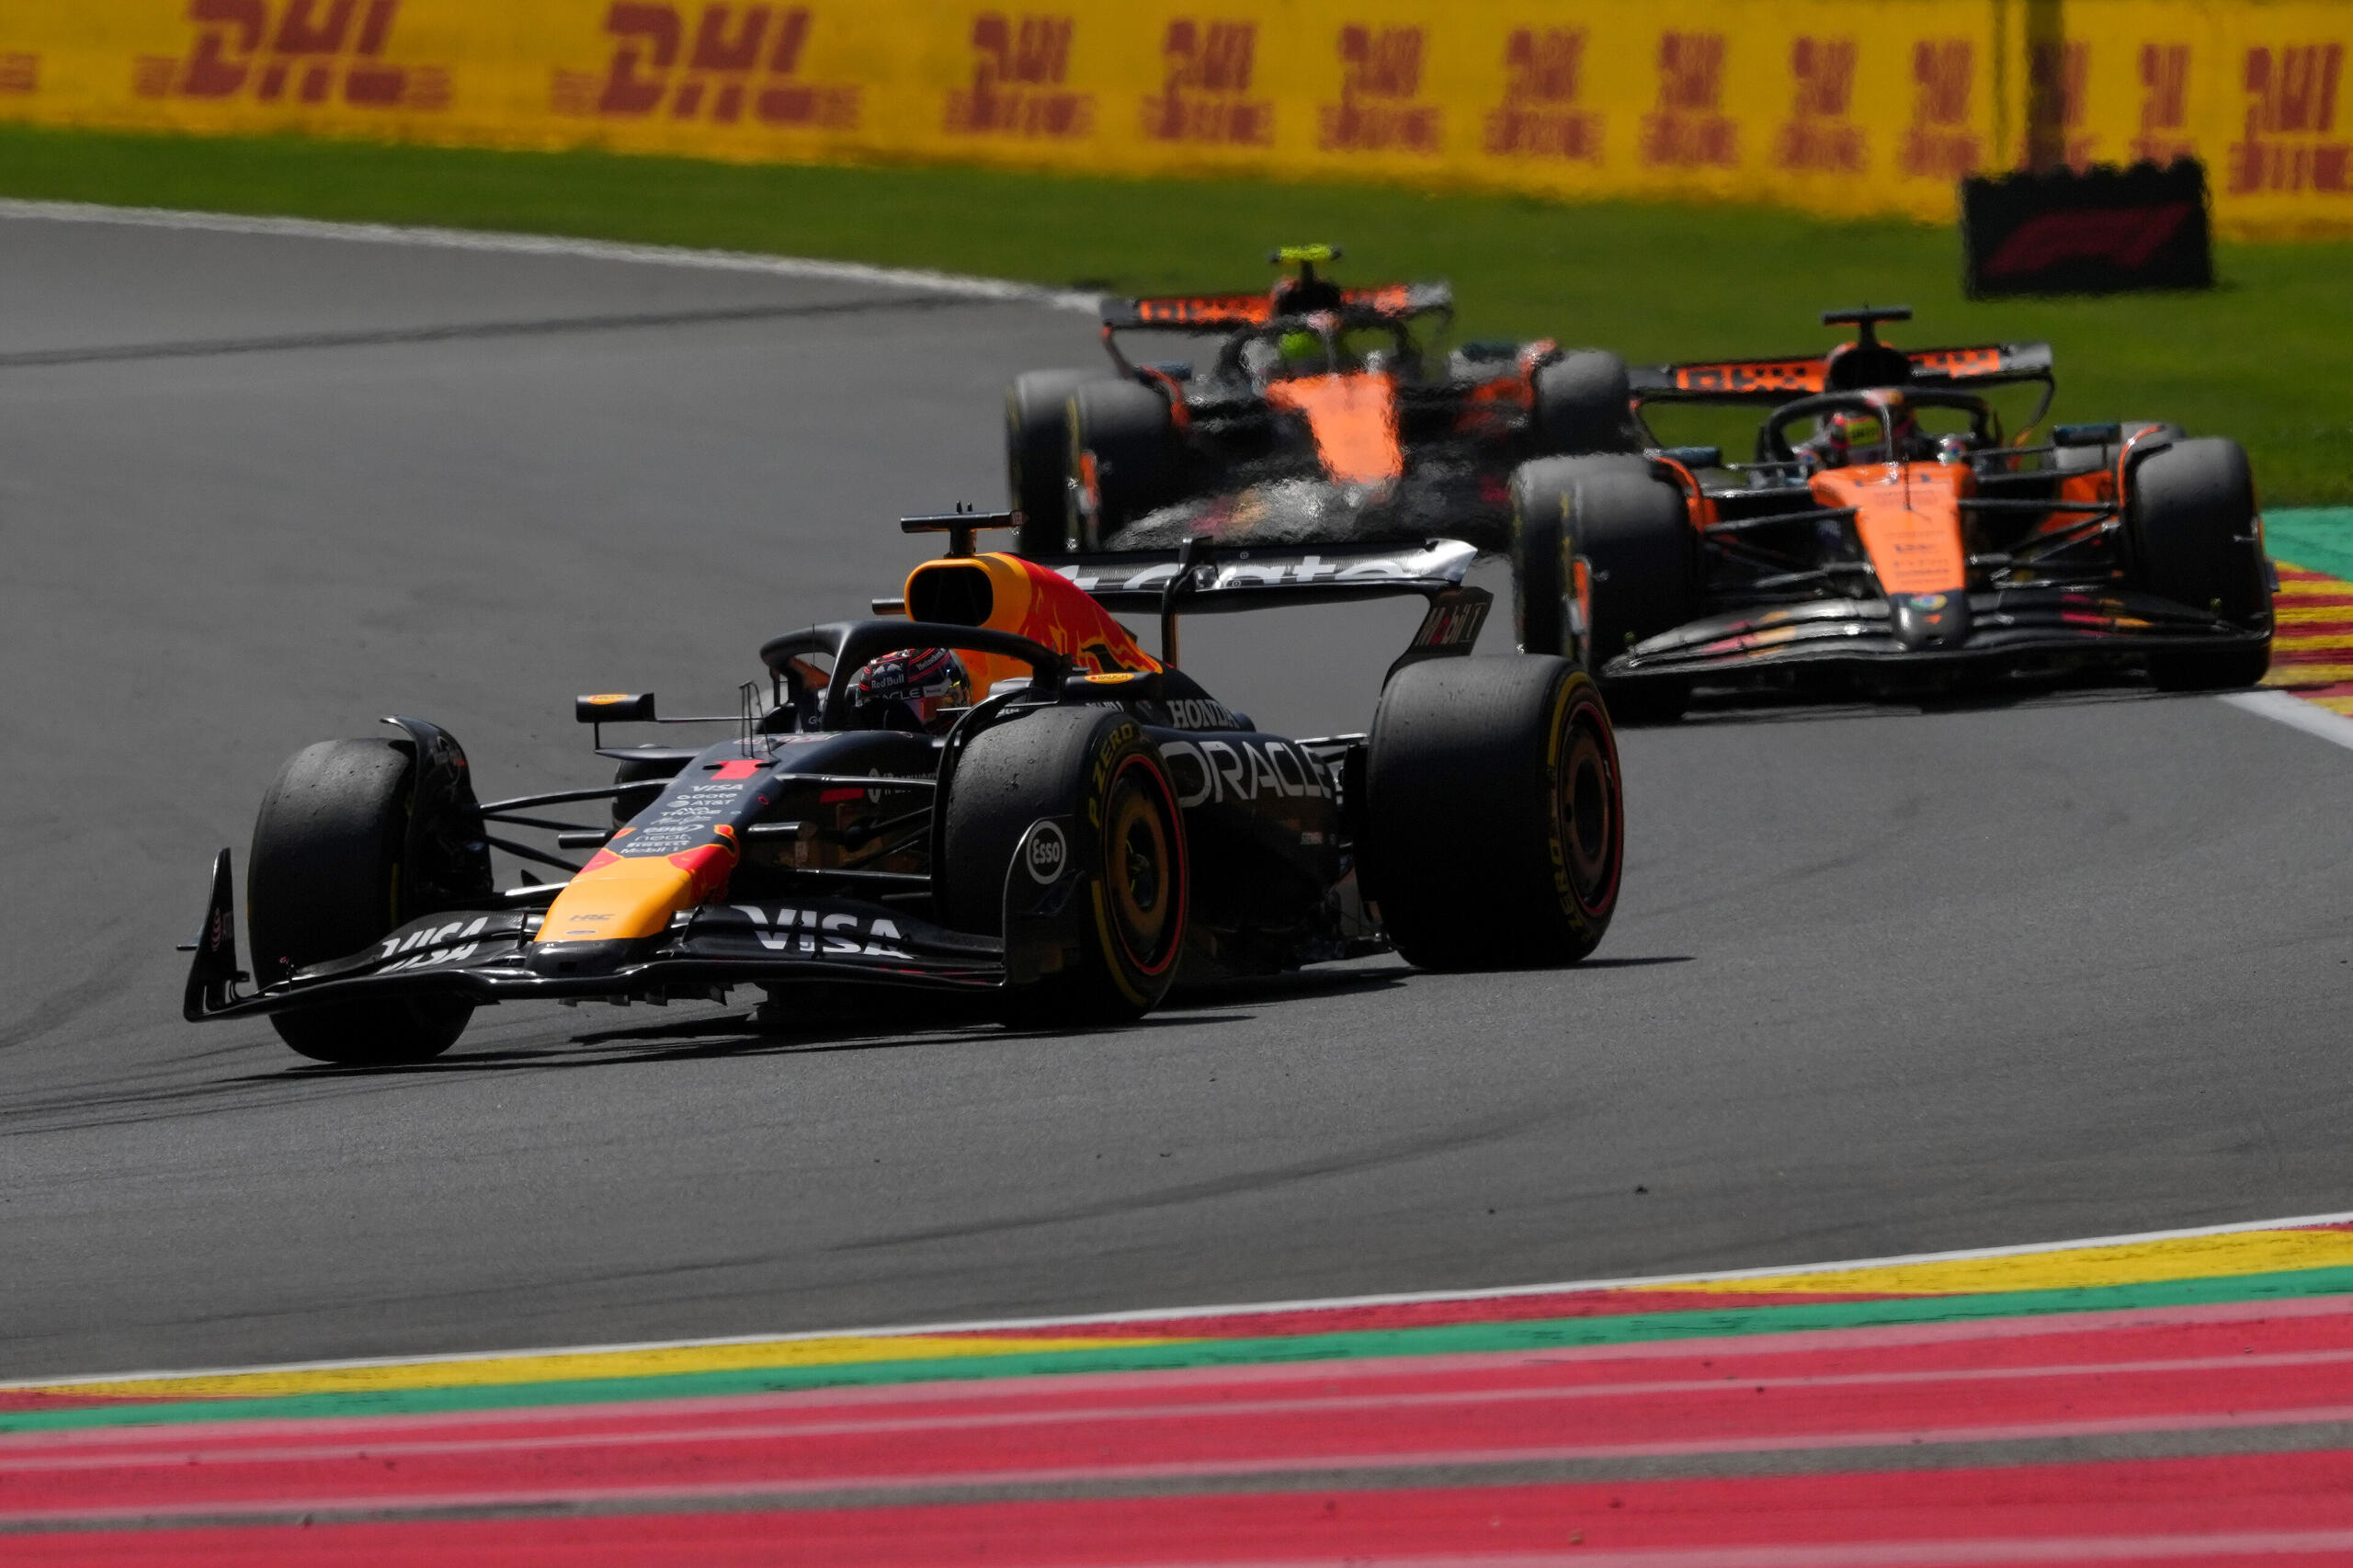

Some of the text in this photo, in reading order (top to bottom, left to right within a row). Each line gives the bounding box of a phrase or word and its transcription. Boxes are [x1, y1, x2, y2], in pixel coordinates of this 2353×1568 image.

[182, 0, 407, 104] DHL
[598, 3, 815, 124] DHL
[871, 674, 905, 688] Red Bull
[1166, 699, 1240, 729] HONDA
[1092, 722, 1133, 794] ZERO
[1159, 741, 1332, 809] ORACLE
[692, 784, 744, 792] VISA
[1032, 837, 1059, 865] Esso
[374, 916, 488, 975] VISA
[730, 905, 914, 960] VISA
